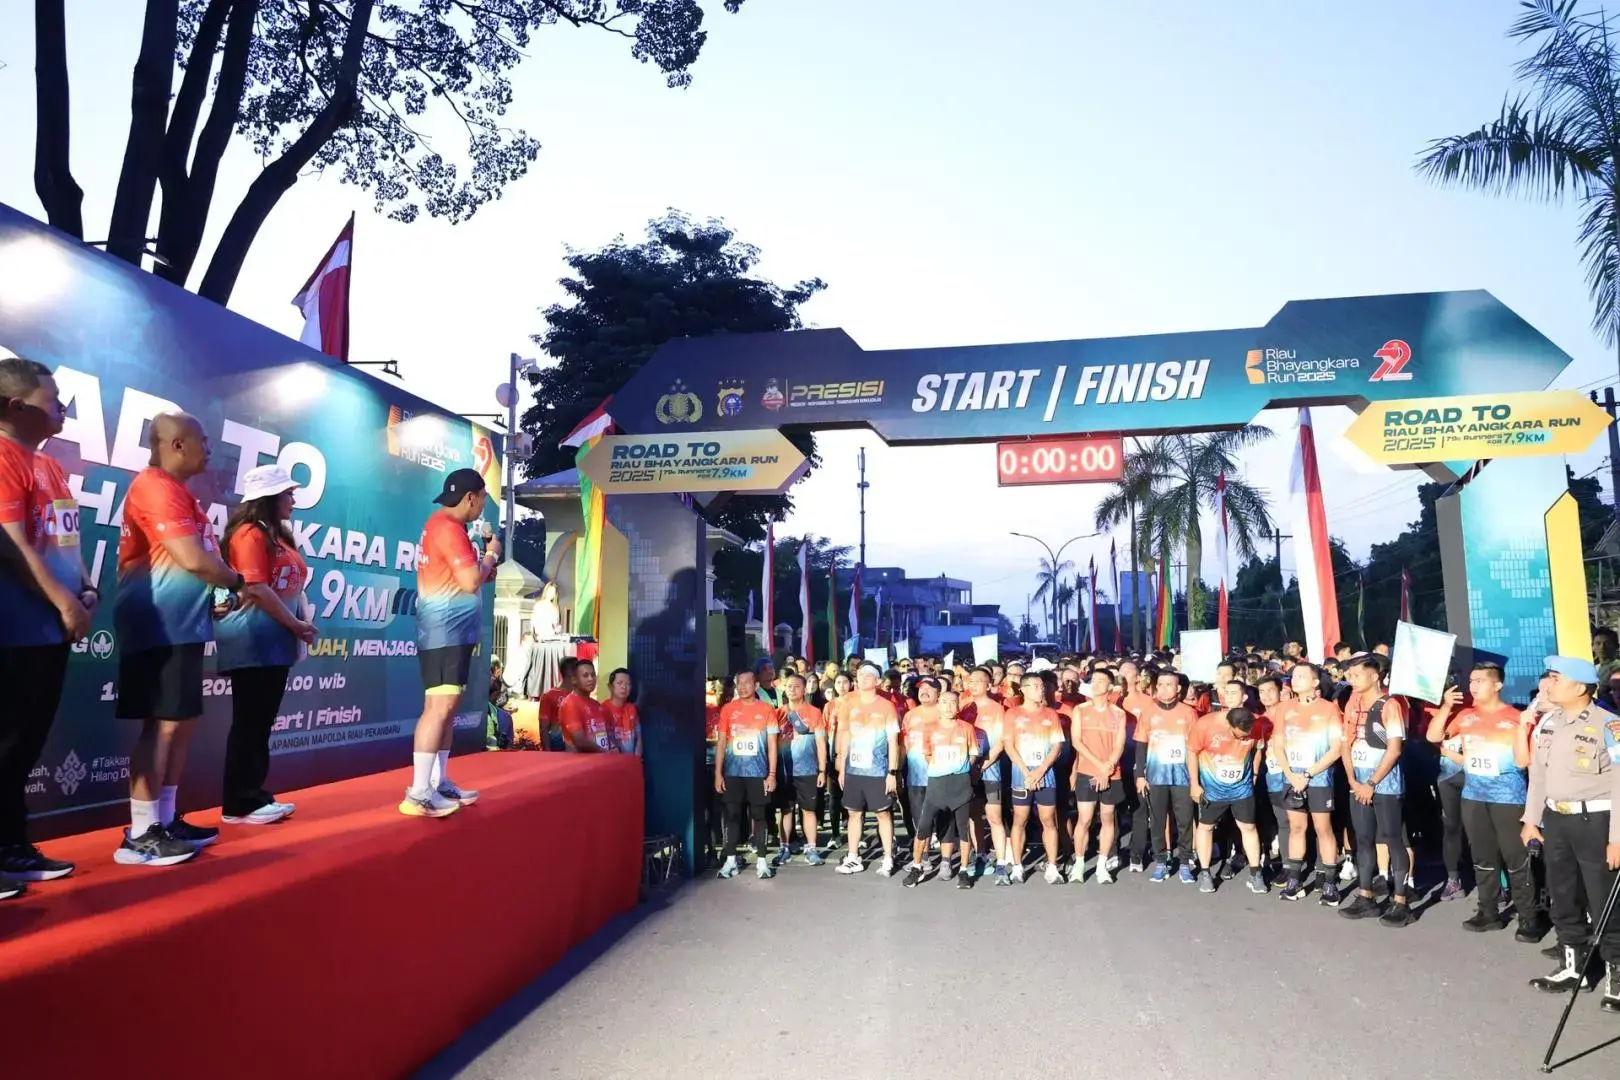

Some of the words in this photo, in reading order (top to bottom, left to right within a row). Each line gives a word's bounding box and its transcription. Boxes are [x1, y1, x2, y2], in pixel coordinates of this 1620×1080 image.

[1266, 348, 1296, 359] Riau
[1266, 357, 1360, 373] Bhayangkara
[911, 369, 1042, 413] START
[1073, 358, 1211, 406] FINISH
[1268, 372, 1295, 384] Run
[1298, 371, 1336, 382] 2025
[790, 380, 886, 401] PRESISI
[1384, 407, 1463, 427] ROAD
[1472, 404, 1511, 421] TO
[1383, 426, 1419, 437] RIAU
[1423, 419, 1543, 435] BHAYANGKARA
[1548, 417, 1581, 428] RUN
[612, 443, 680, 460] ROAD
[686, 441, 721, 457] TO
[1383, 436, 1437, 452] 2025
[221, 419, 327, 510] TO
[610, 460, 641, 470] RIAU
[644, 456, 747, 469] BHAYANGKARA
[750, 455, 779, 465] RUN
[1001, 445, 1116, 476] 0:00:00
[609, 469, 656, 483] 2025
[319, 672, 347, 690] wib
[316, 704, 362, 727] Finish
[270, 735, 311, 752] APANGAN
[311, 730, 346, 745] MAPOLDA
[736, 740, 755, 751] 016
[1470, 756, 1493, 770] 215
[1221, 769, 1242, 780] 387
